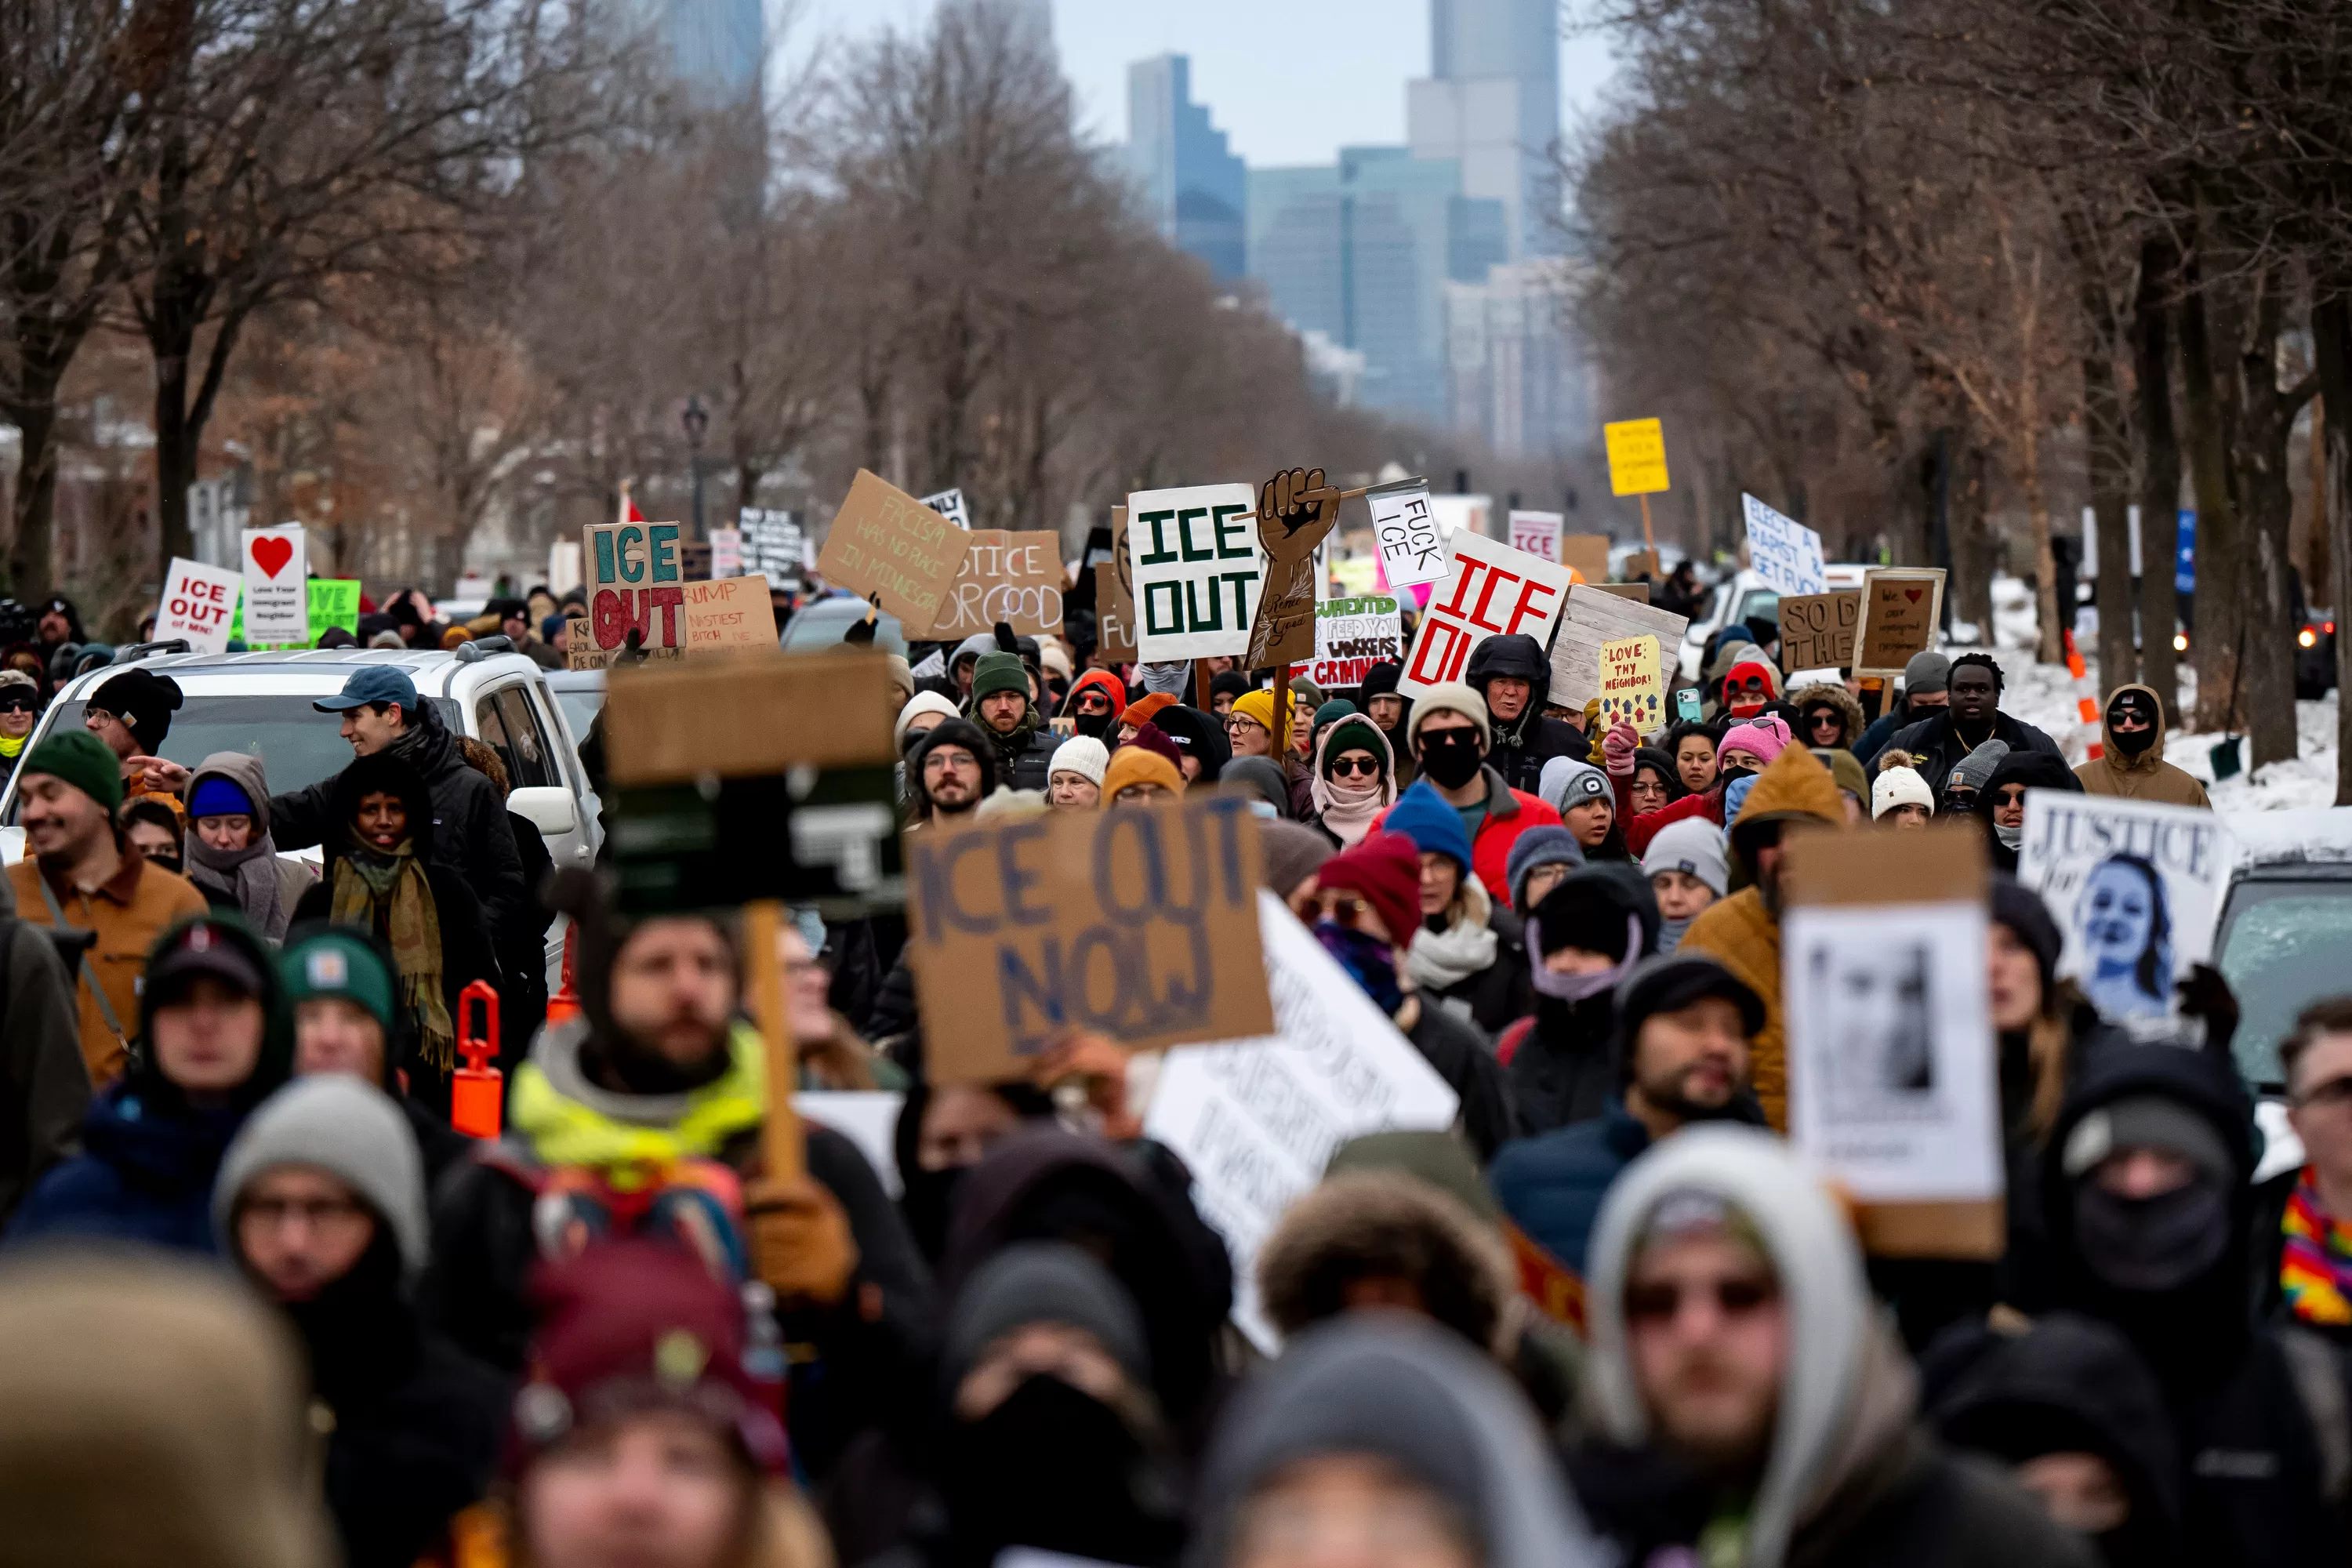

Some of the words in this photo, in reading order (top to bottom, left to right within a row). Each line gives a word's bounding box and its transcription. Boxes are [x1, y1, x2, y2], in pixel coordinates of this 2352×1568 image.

[1138, 504, 1253, 565] ICE
[1377, 514, 1411, 561] ICE
[1405, 499, 1442, 571] FUCK
[1514, 534, 1554, 555] ICE
[594, 525, 678, 583] ICE
[180, 576, 227, 603] ICE
[1144, 571, 1259, 636] OUT
[169, 598, 228, 626] OUT
[593, 586, 684, 651] OUT
[688, 612, 744, 629] NASTIEST
[1267, 612, 1306, 646] Good
[1327, 619, 1365, 639] FEED
[1366, 617, 1400, 639] YOU
[1784, 598, 1830, 633] SO
[691, 630, 721, 643] BITCH
[1609, 643, 1642, 662] LOVE
[573, 655, 587, 671] BE
[1614, 662, 1636, 677] THY
[2031, 808, 2215, 884] JUSTICE
[914, 822, 1052, 945] ICE
[1094, 796, 1248, 927] OUT
[999, 925, 1212, 1026] NOW
